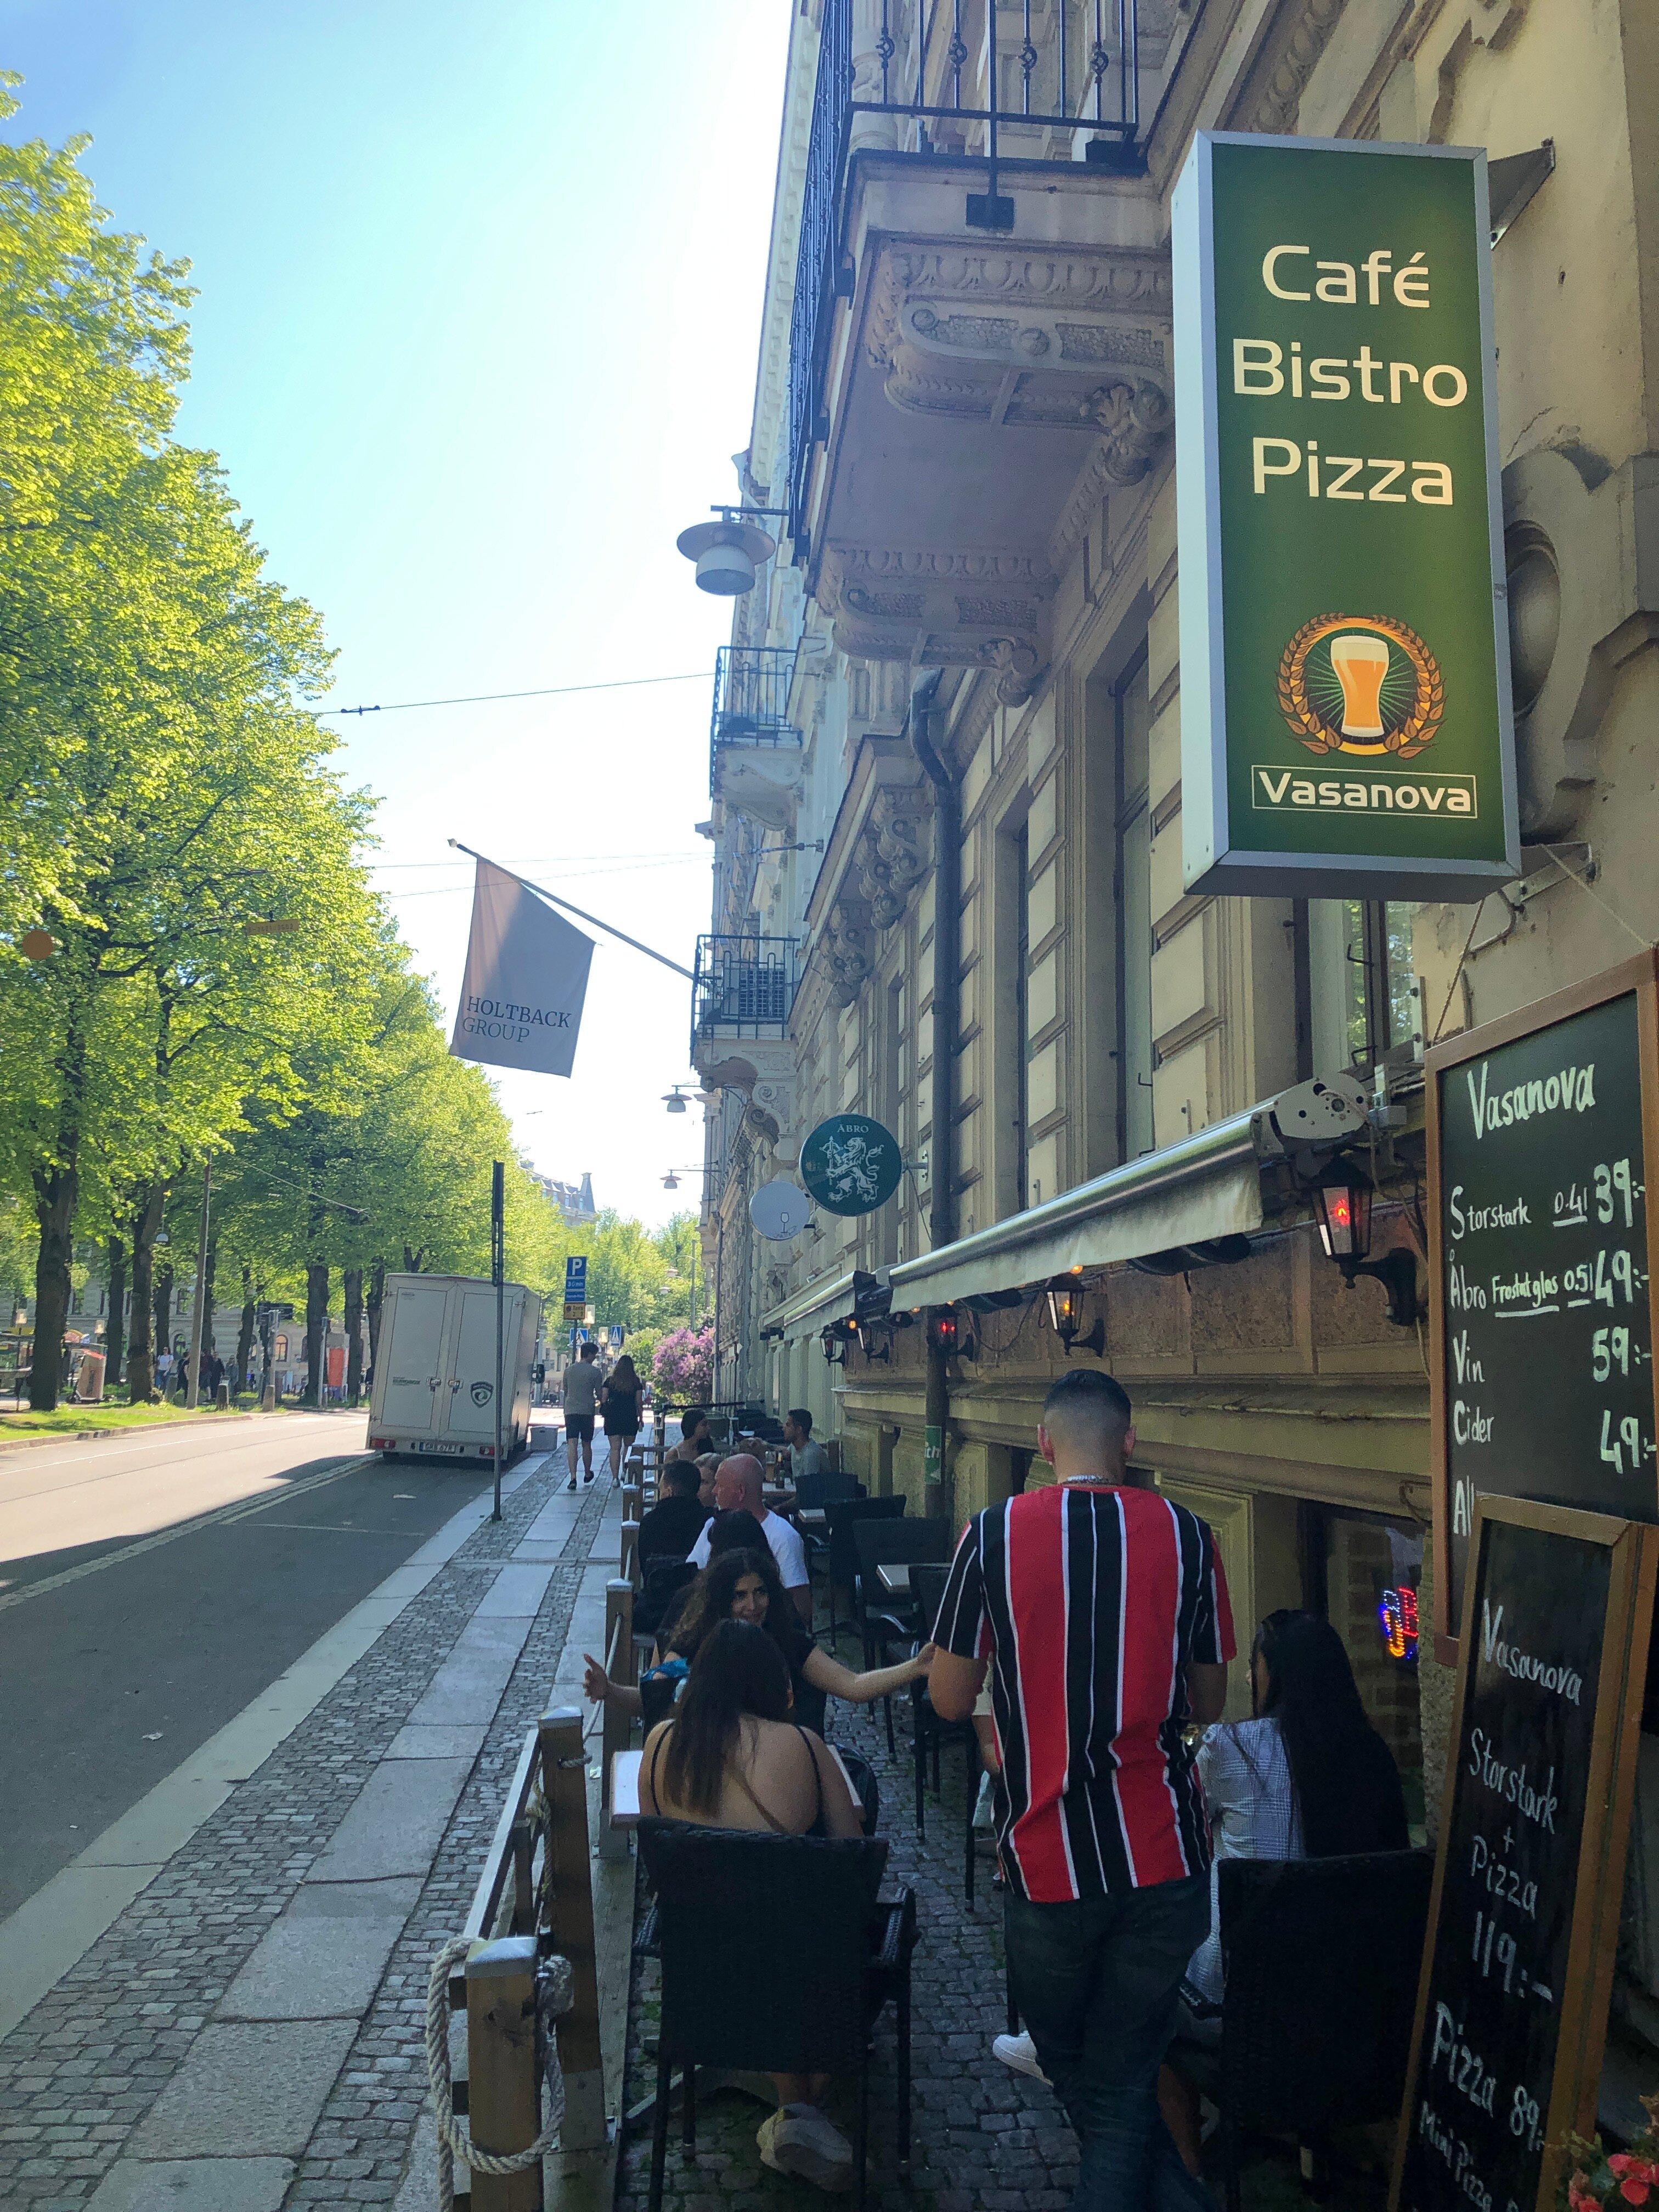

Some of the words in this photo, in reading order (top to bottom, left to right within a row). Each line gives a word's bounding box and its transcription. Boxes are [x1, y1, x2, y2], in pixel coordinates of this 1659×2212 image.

[1262, 244, 1430, 308] Café
[1232, 338, 1468, 407] Bistro
[1252, 437, 1453, 505] Pizza
[1259, 771, 1471, 812] Vasanova
[462, 1017, 530, 1043] GROUP
[467, 996, 572, 1028] HOLTBACK
[1466, 1061, 1596, 1139] Vasanova
[1450, 1186, 1532, 1240] Storstark
[572, 1259, 582, 1276] P
[1449, 1248, 1487, 1311] Åbro
[1532, 1271, 1559, 1308] glas
[1453, 1329, 1485, 1384] Vin
[1593, 1327, 1652, 1383] 59:-
[1453, 1400, 1494, 1445] Cider
[1482, 1598, 1583, 1706] Vasanova
[1470, 1728, 1558, 1835] Storstark
[1470, 1835, 1538, 1920] Pizza
[1430, 2000, 1497, 2118] Pizza
